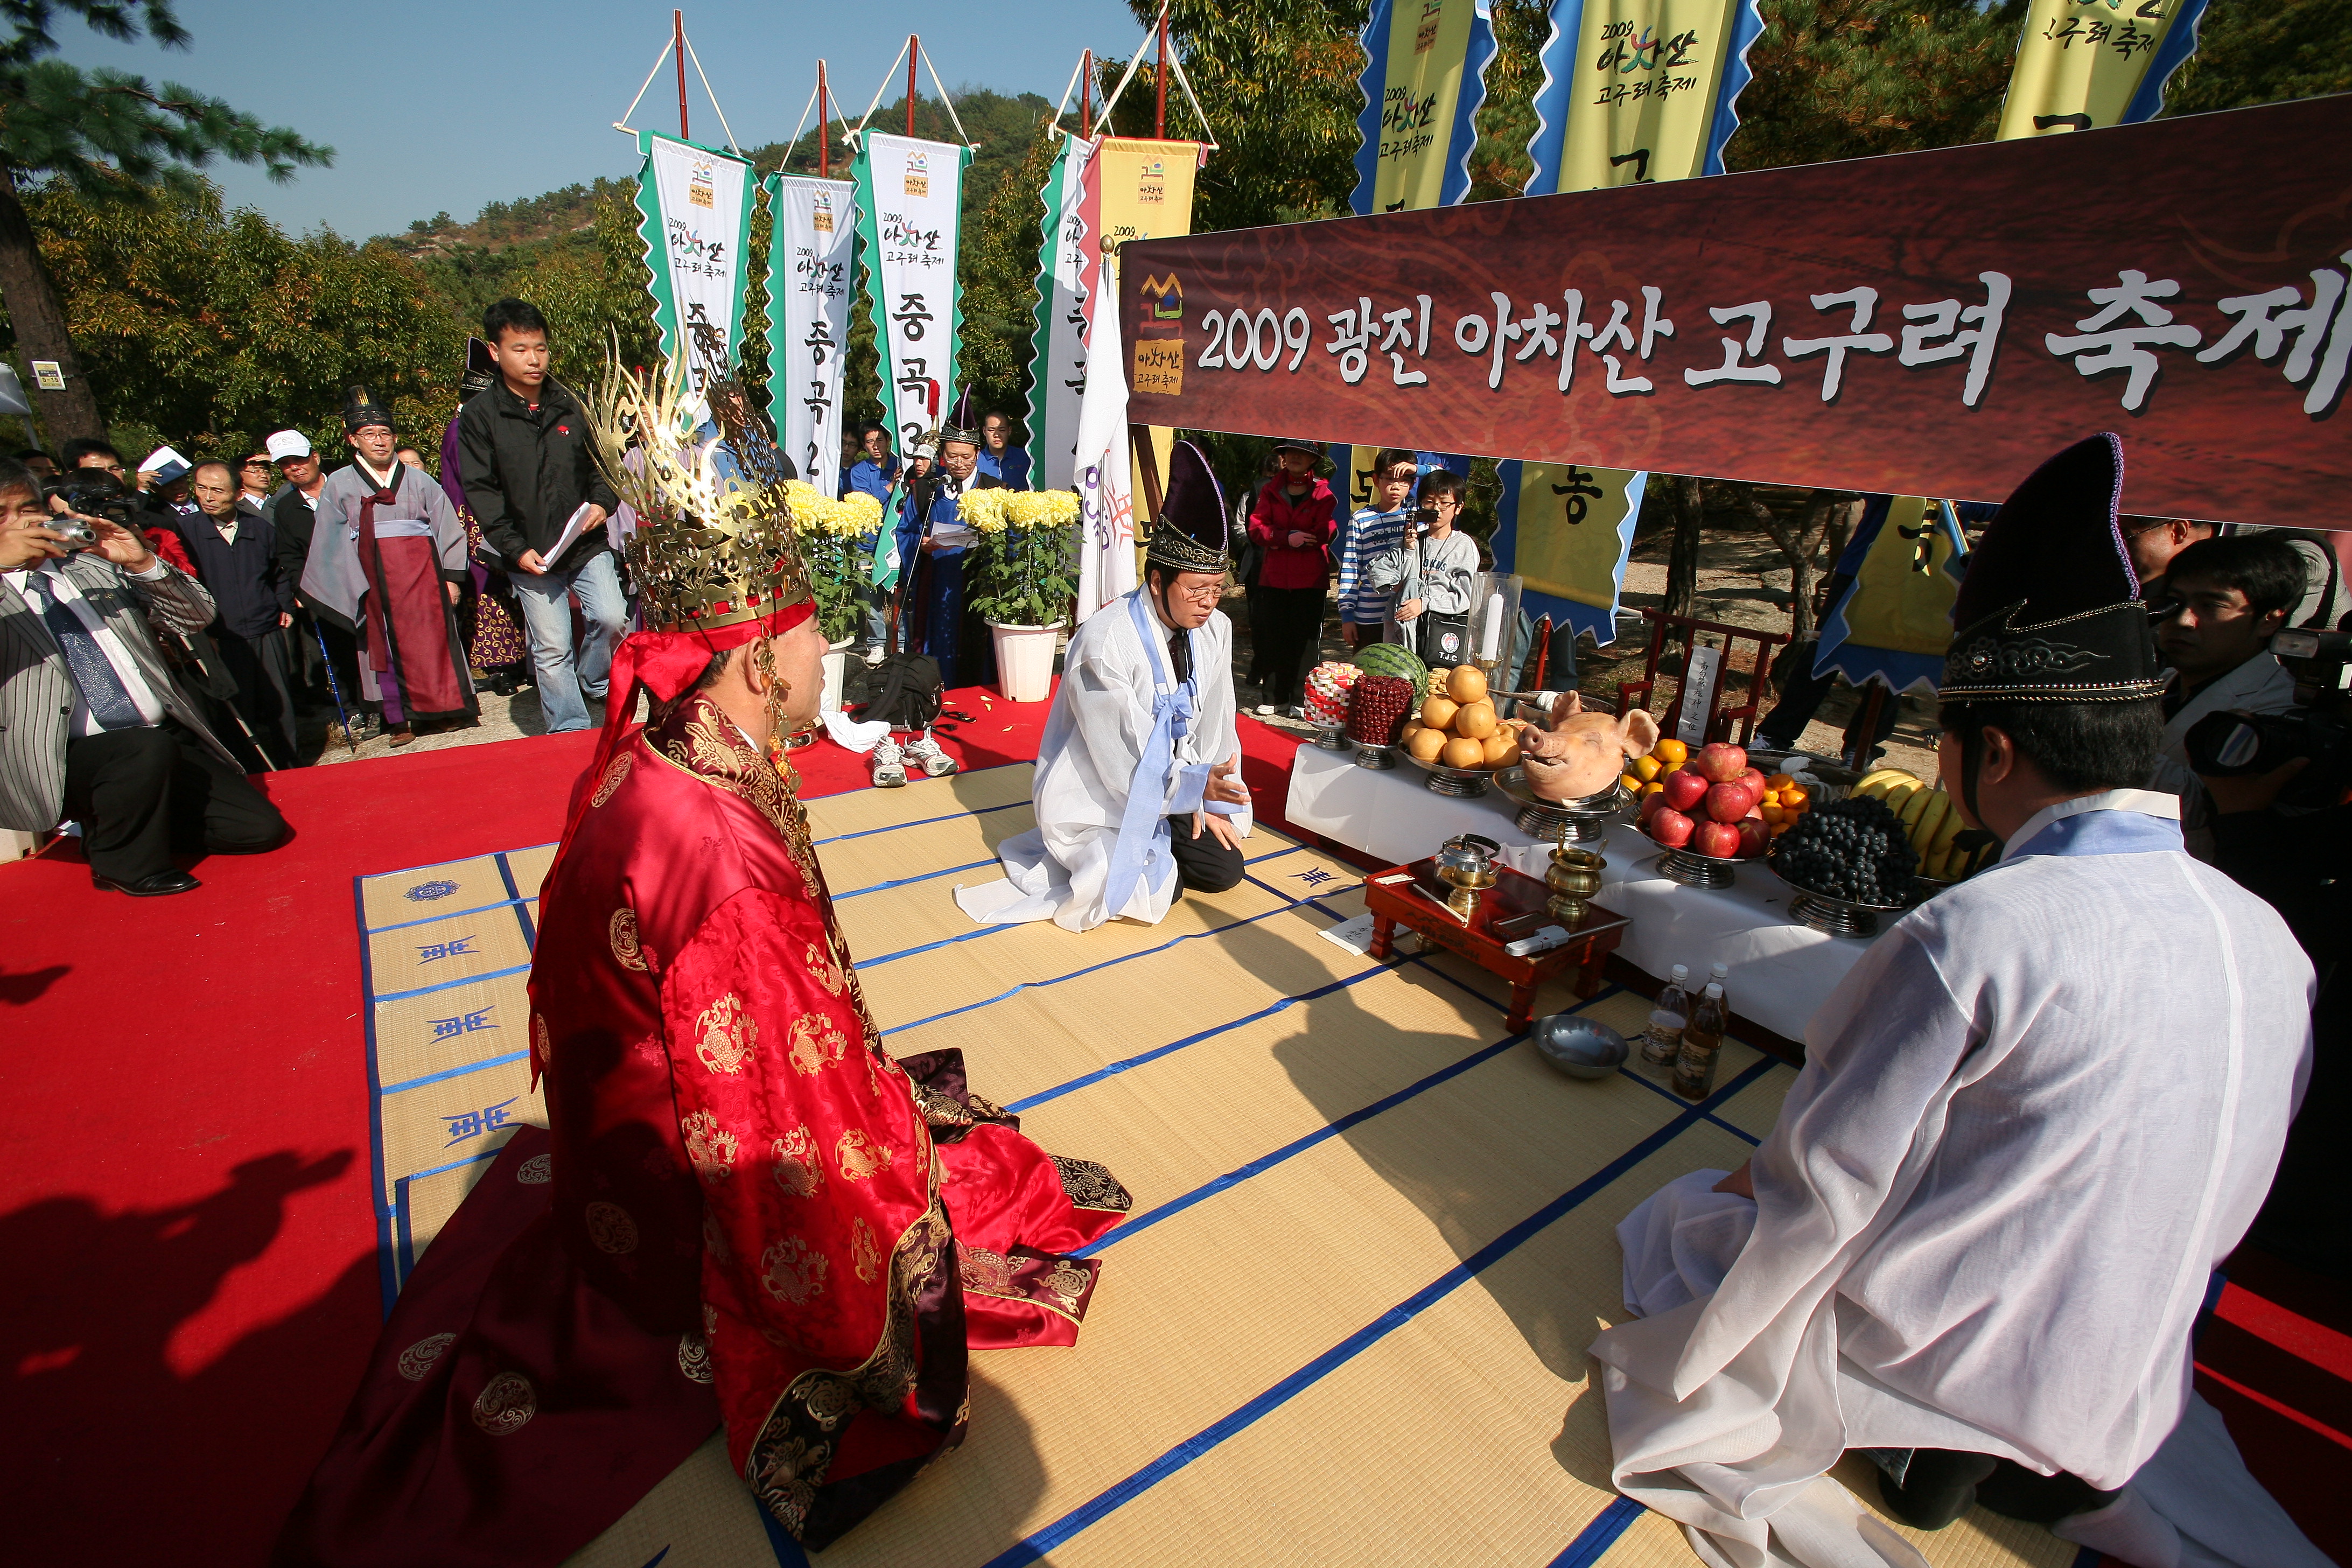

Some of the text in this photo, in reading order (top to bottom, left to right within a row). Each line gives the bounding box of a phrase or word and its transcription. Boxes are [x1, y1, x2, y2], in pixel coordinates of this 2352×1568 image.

[1600, 20, 1634, 40] 2009
[1384, 86, 1407, 103] 2009
[669, 217, 687, 232] 2009
[883, 212, 902, 223] 2009
[1114, 225, 1136, 237] 2009
[796, 247, 814, 257] 2009
[1196, 307, 1311, 371] 2009
[1326, 293, 1433, 384] 광진
[1454, 285, 1674, 394] 아차산
[1683, 270, 2013, 407] 고구려
[2045, 249, 2352, 415] 축제
[1138, 346, 1180, 369] 아차산
[1439, 651, 1458, 662] T.J.C
